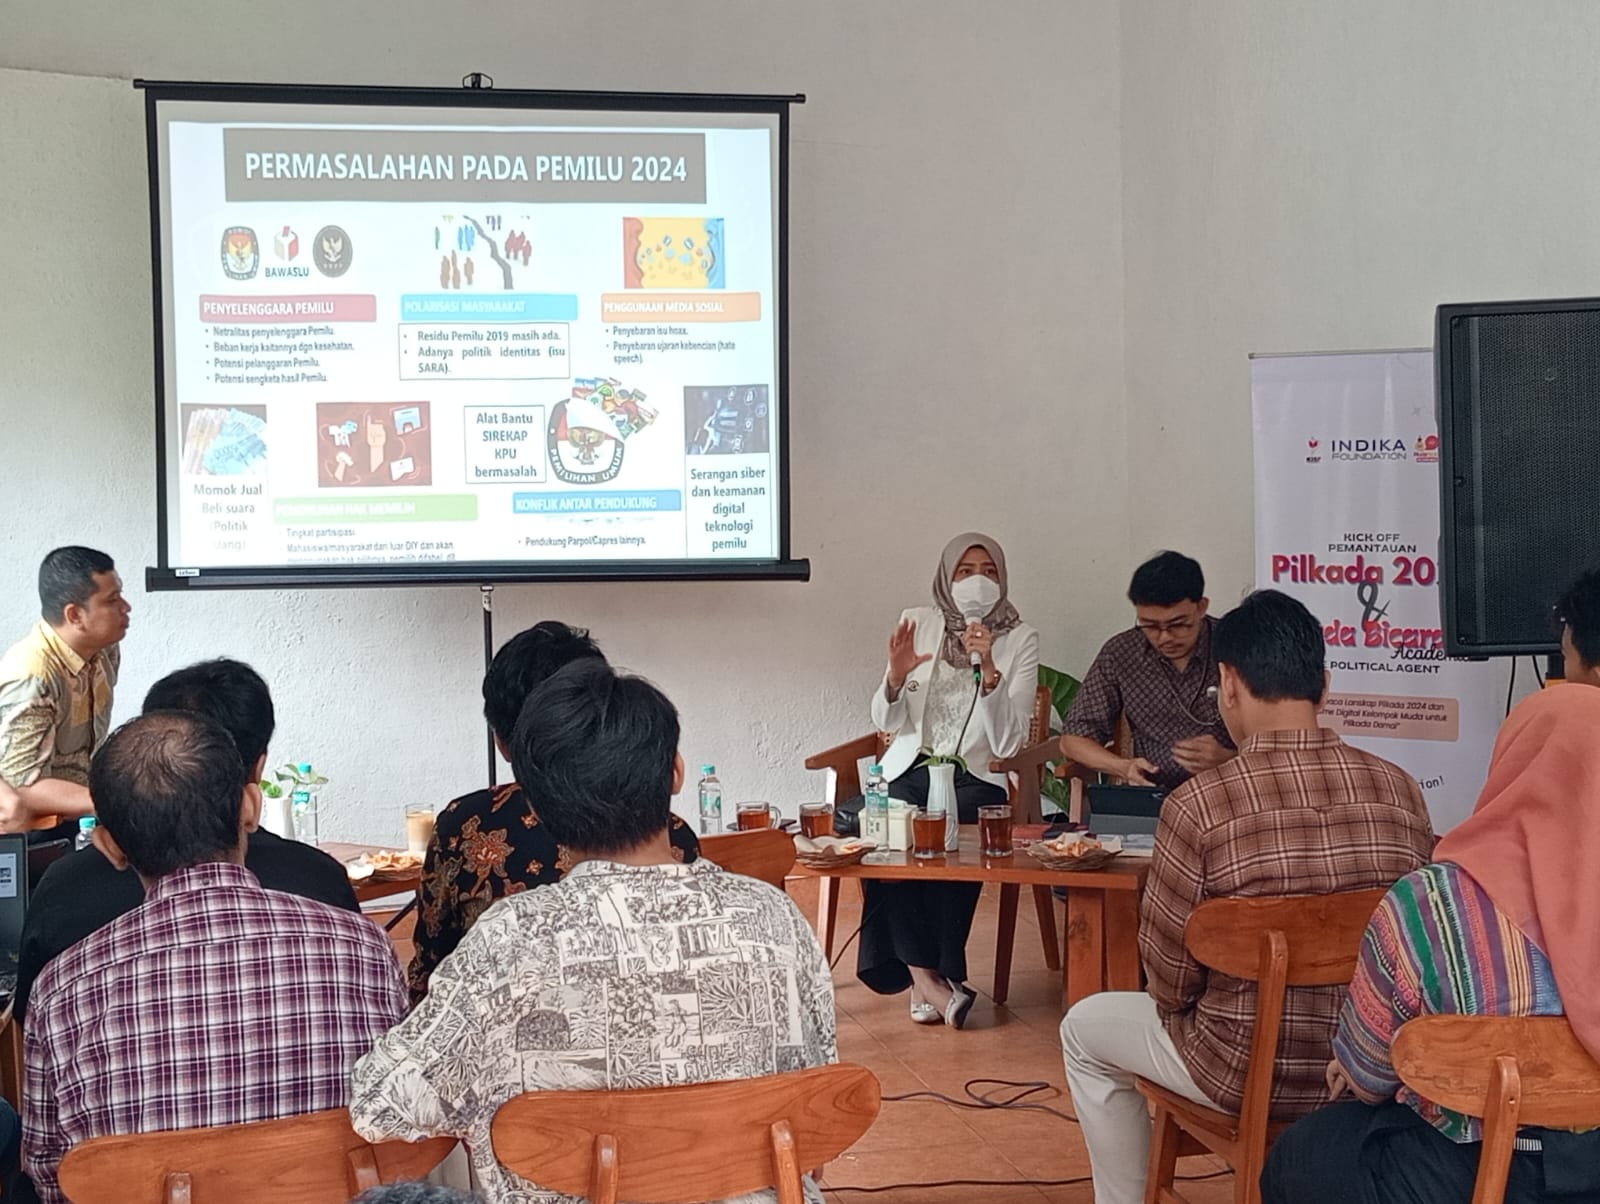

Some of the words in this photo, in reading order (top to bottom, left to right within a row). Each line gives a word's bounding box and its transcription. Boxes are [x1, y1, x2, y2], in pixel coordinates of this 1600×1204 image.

[245, 152, 454, 181] PERMASALAHAN
[462, 154, 529, 181] PADA
[535, 155, 624, 182] PEMILU
[631, 156, 687, 182] 2024
[265, 267, 310, 278] BAWASLU
[203, 301, 294, 316] PENYELENGGARA
[295, 301, 334, 315] PEMILU
[604, 301, 664, 313] PENGGUNAAN
[666, 301, 694, 313] MEDIA
[695, 301, 725, 313] SOSIAL
[213, 326, 250, 337] Netralitas
[252, 327, 307, 340] penyelenggara
[418, 330, 449, 341] Residu
[451, 330, 484, 341] Pemilu
[486, 330, 509, 341] 2019
[511, 330, 540, 341] masih
[541, 330, 561, 341] ada.
[613, 325, 656, 338] Penyebaran
[656, 326, 668, 336] isu
[214, 341, 239, 352] Beban
[240, 342, 259, 354] kerja
[261, 342, 297, 354] kaitannya
[299, 342, 313, 354] dgn
[418, 346, 454, 360] Adanya
[462, 346, 492, 360] politik
[500, 346, 540, 357] identitas
[548, 346, 566, 358] (isu
[613, 340, 656, 353] Penyebaran
[657, 341, 680, 352] ujaran
[680, 340, 717, 351] kebencian
[717, 340, 736, 352] (hate
[214, 357, 244, 369] Potensi
[245, 358, 293, 371] pelanggaran
[418, 362, 451, 375] SARA).
[214, 373, 244, 384] Potensi
[246, 374, 280, 386] sengketa
[281, 373, 299, 383] hasil
[476, 412, 498, 425] Alat
[501, 412, 533, 425] Bantu
[482, 430, 528, 442] SIREKAP
[1331, 439, 1406, 452] INDIKA
[494, 448, 517, 460] KPU
[1331, 452, 1407, 461] FOUNDATION
[550, 448, 596, 482] PEMILIHAN
[602, 447, 623, 481] UMUM
[475, 465, 537, 478] bermasalah
[690, 468, 739, 483] Serangan
[741, 467, 766, 479] siber
[193, 483, 237, 496] Momok
[240, 482, 263, 496] Jual
[691, 485, 711, 497] dan
[712, 484, 766, 497] keamanan
[201, 502, 222, 514] Beli
[226, 504, 255, 514] suara
[516, 497, 559, 511] KONFLIK
[559, 497, 592, 510] ANTAR
[594, 496, 657, 509] PENDUKUNG
[712, 502, 745, 516] digital
[704, 519, 754, 533] teknologi
[286, 528, 315, 539] Tingkat
[1343, 533, 1374, 542] KICK
[1376, 533, 1400, 542] OFF
[405, 540, 419, 550] DIY
[420, 541, 434, 550] dan
[435, 541, 454, 550] akan
[525, 536, 566, 548] Pendukung
[711, 537, 747, 551] pemilu
[1328, 543, 1417, 553] PEMANTAUAN
[1272, 554, 1384, 585] Pilkada
[1391, 555, 1440, 587] 20
[1324, 618, 1357, 648] da
[1330, 661, 1393, 672] POLITICAL
[1396, 663, 1441, 674] AGENT
[1344, 699, 1377, 708] Lanskap
[1378, 700, 1405, 709] Pilkada
[1406, 701, 1427, 710] 2024
[1428, 702, 1445, 711] dan
[1335, 708, 1361, 718] Digital
[1361, 710, 1398, 720] Kelompok
[1400, 711, 1424, 721] Muda
[1425, 714, 1448, 722] untuk
[1343, 719, 1371, 728] Pilkada
[1418, 775, 1446, 790] ion!
